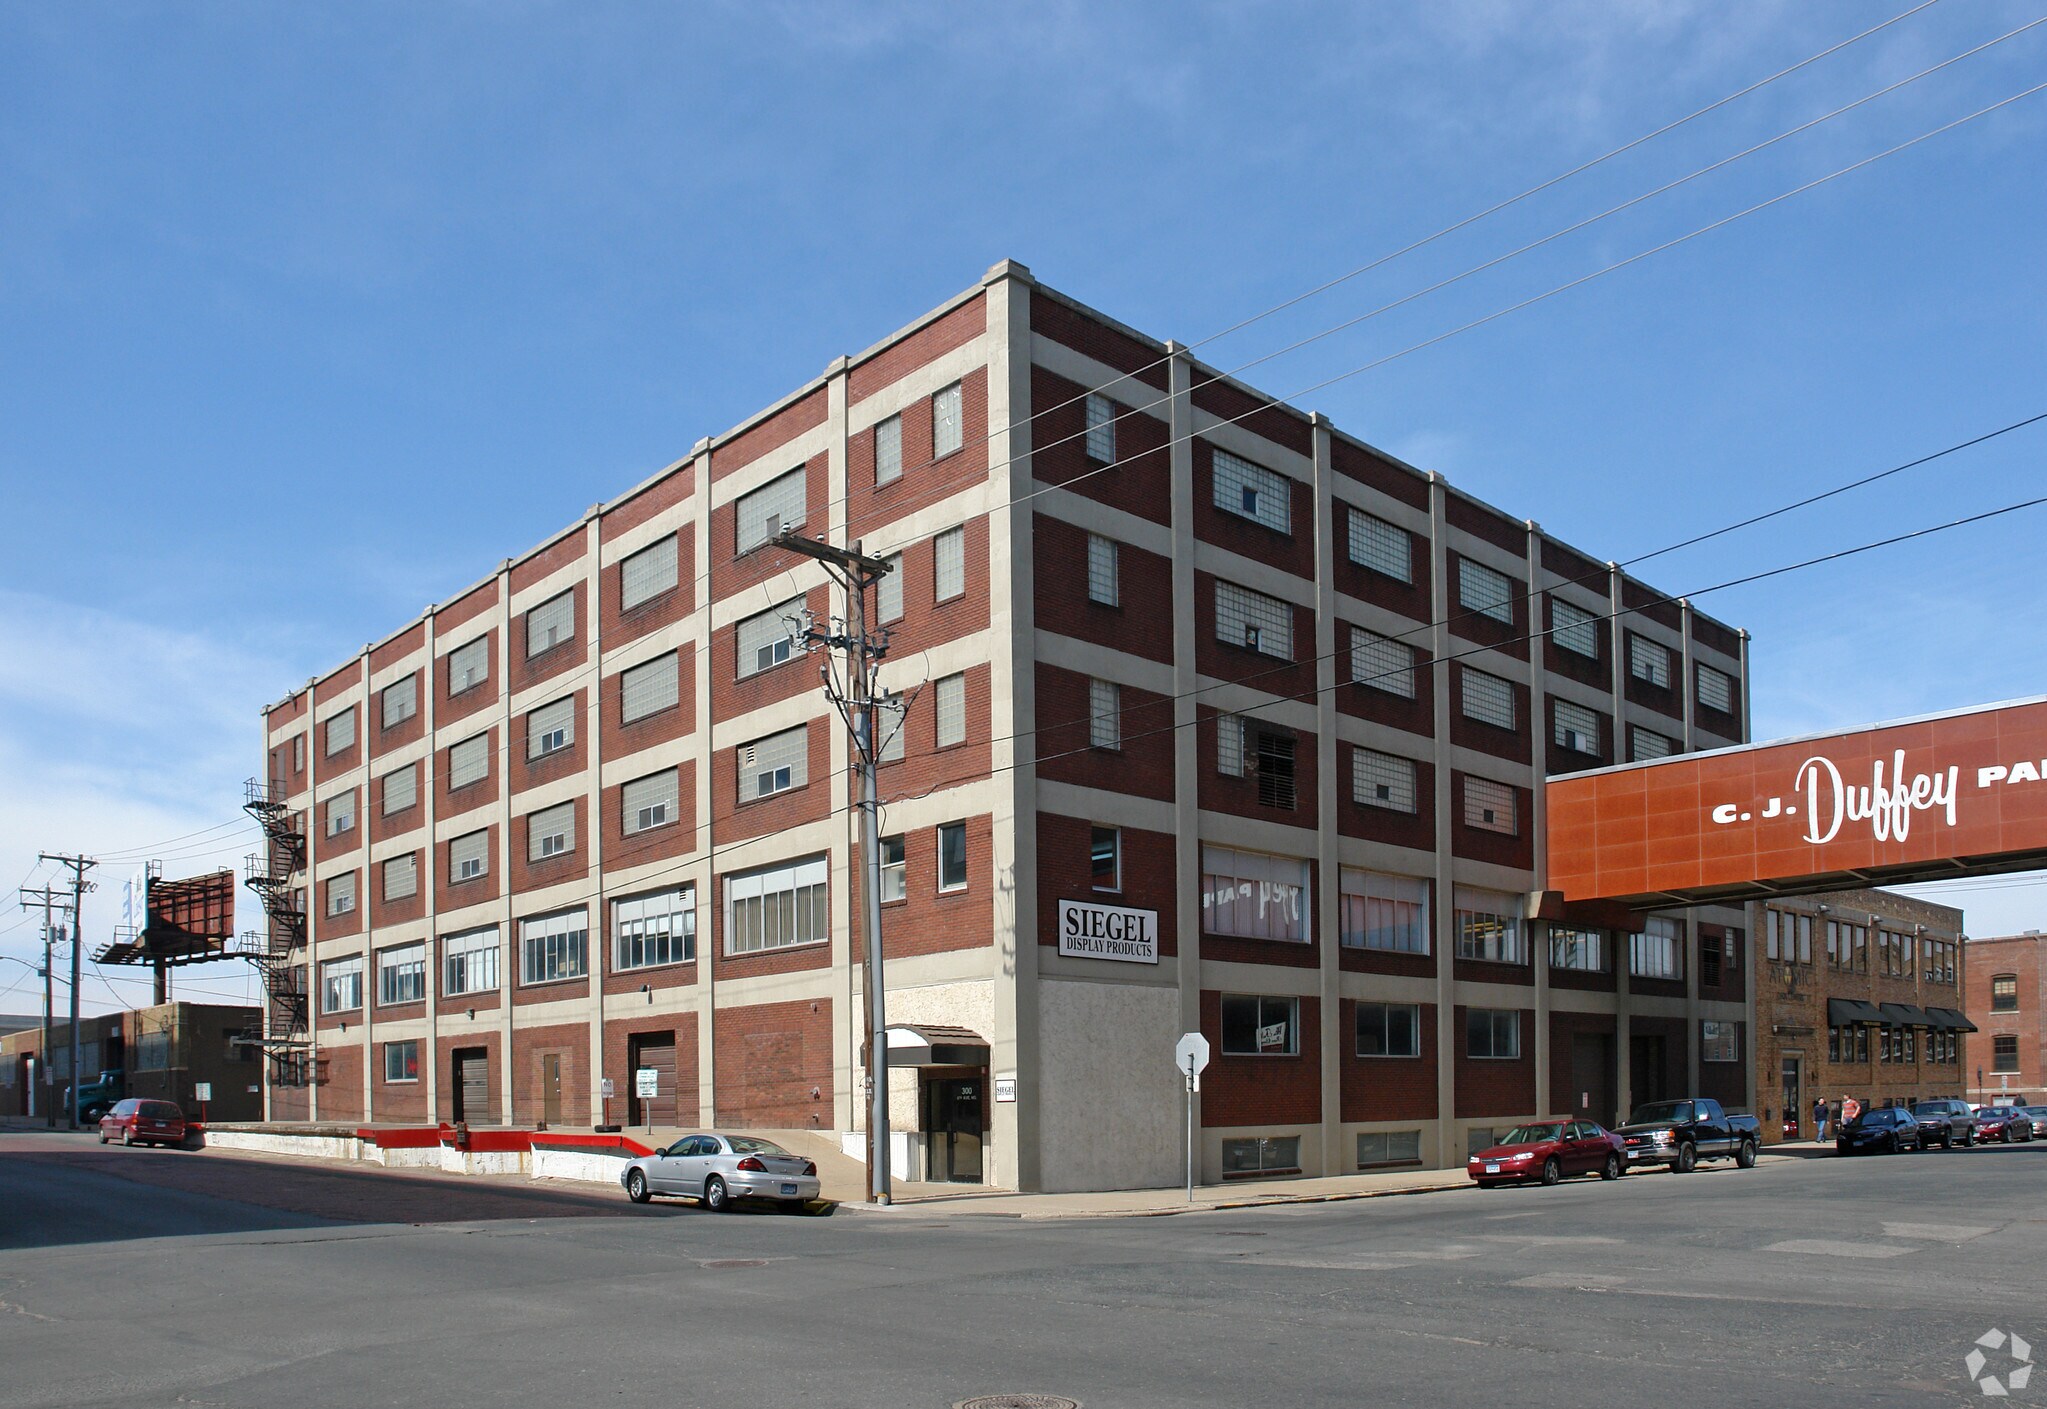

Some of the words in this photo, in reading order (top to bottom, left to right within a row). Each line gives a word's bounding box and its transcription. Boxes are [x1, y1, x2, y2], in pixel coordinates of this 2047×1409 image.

[1712, 803, 1751, 824] C.
[1762, 797, 1797, 818] J.
[1794, 748, 1959, 845] Duffey
[1066, 907, 1151, 943] SIEGEL
[1066, 937, 1105, 953] DISPLAY
[1106, 941, 1152, 957] PRODUCTS
[961, 1087, 973, 1095] 300
